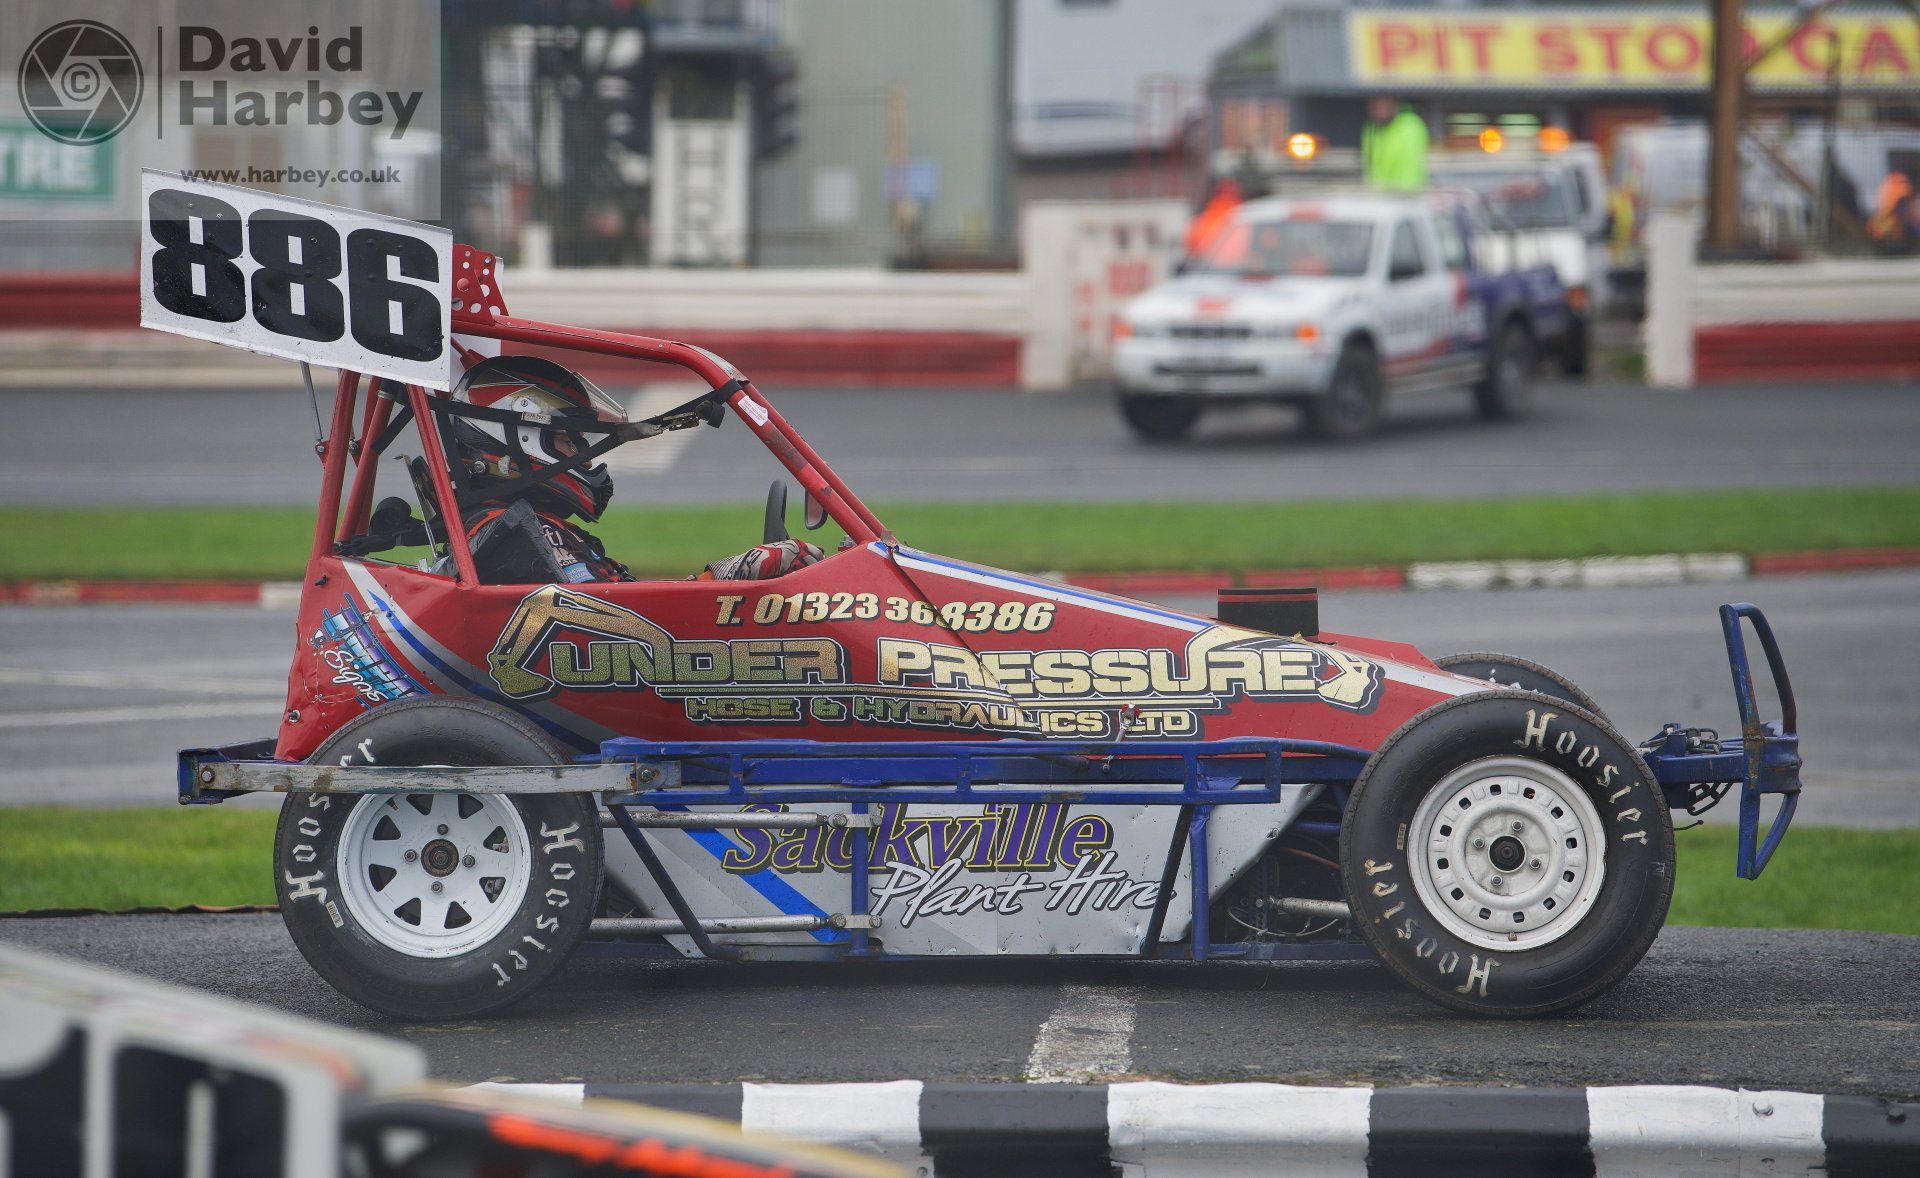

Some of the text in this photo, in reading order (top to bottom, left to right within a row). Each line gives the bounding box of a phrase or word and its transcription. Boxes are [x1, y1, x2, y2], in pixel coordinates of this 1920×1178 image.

[1373, 25, 1919, 72] PIT STO CA
[149, 189, 443, 362] 886
[715, 592, 1056, 632] T. 01323 368386
[323, 649, 390, 702] Signs
[550, 637, 1320, 697] UNDER PRESSURE
[686, 697, 800, 720] HOSE
[811, 697, 847, 721] &
[853, 696, 1111, 738] HYDRAULICS
[871, 858, 1045, 928] Plant
